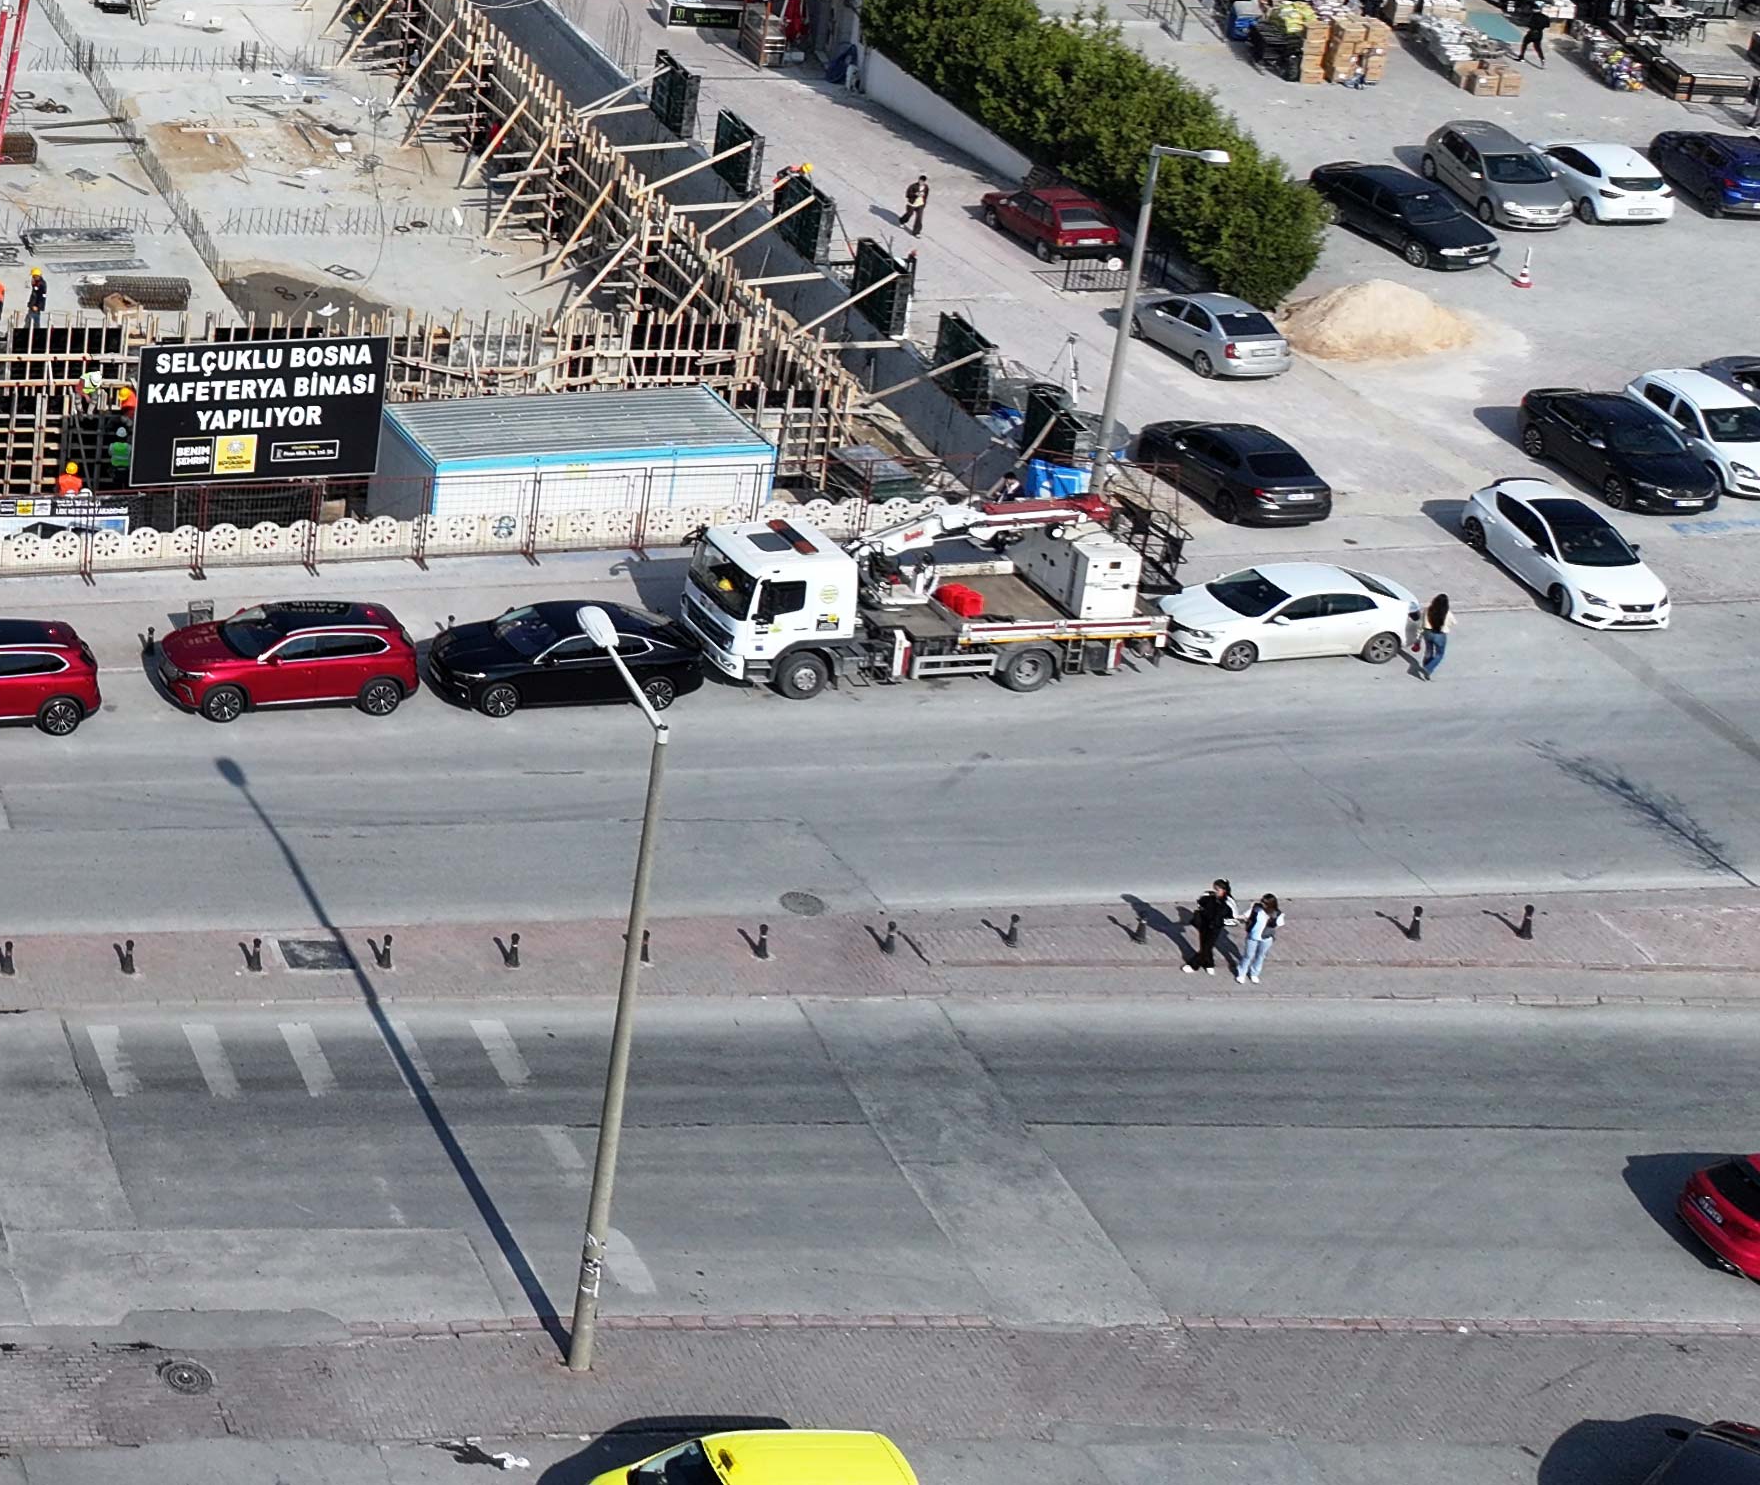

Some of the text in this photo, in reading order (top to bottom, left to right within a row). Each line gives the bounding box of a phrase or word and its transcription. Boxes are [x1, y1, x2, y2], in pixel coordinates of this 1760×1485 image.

[155, 344, 373, 376] SELÇUKLU BOSNA
[147, 372, 376, 404] KAFETERYA BİNASI
[197, 405, 322, 431] YAPILIYOR
[176, 446, 211, 457] BENİM
